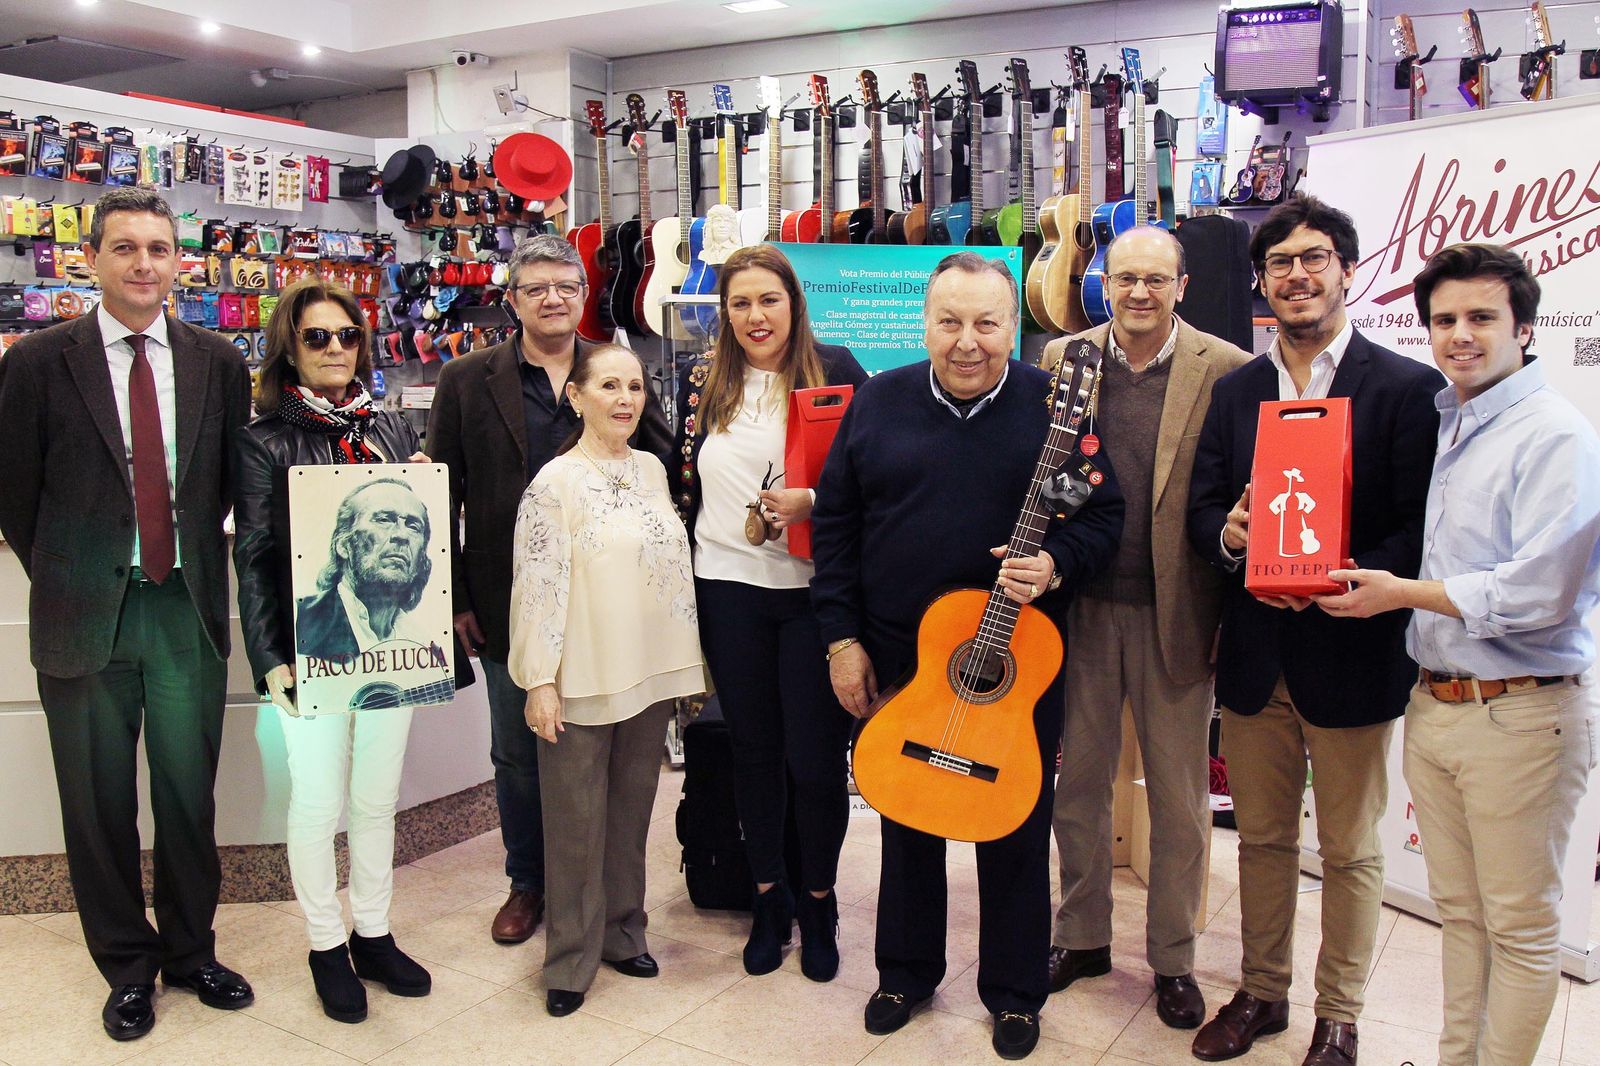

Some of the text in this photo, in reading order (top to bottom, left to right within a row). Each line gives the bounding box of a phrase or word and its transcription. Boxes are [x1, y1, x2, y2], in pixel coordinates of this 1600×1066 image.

[840, 269, 858, 278] Vota
[859, 270, 889, 279] Premio
[890, 270, 903, 279] del
[843, 297, 926, 308] Y gana grandes prem
[825, 310, 848, 319] Clase
[849, 310, 887, 320] magistral
[888, 311, 899, 319] de
[900, 311, 926, 320] castañ
[810, 320, 843, 330] Angelita
[845, 320, 873, 330] Gómez
[874, 323, 880, 331] y
[1350, 314, 1376, 329] esde
[1376, 313, 1415, 329] 1948
[856, 330, 878, 339] Clase
[880, 331, 890, 339] de
[891, 331, 923, 341] guitarra
[844, 340, 867, 349] Otros
[868, 340, 901, 350] premios
[1252, 564, 1283, 577] TIO
[305, 651, 357, 679] PACO
[361, 650, 387, 674] DE
